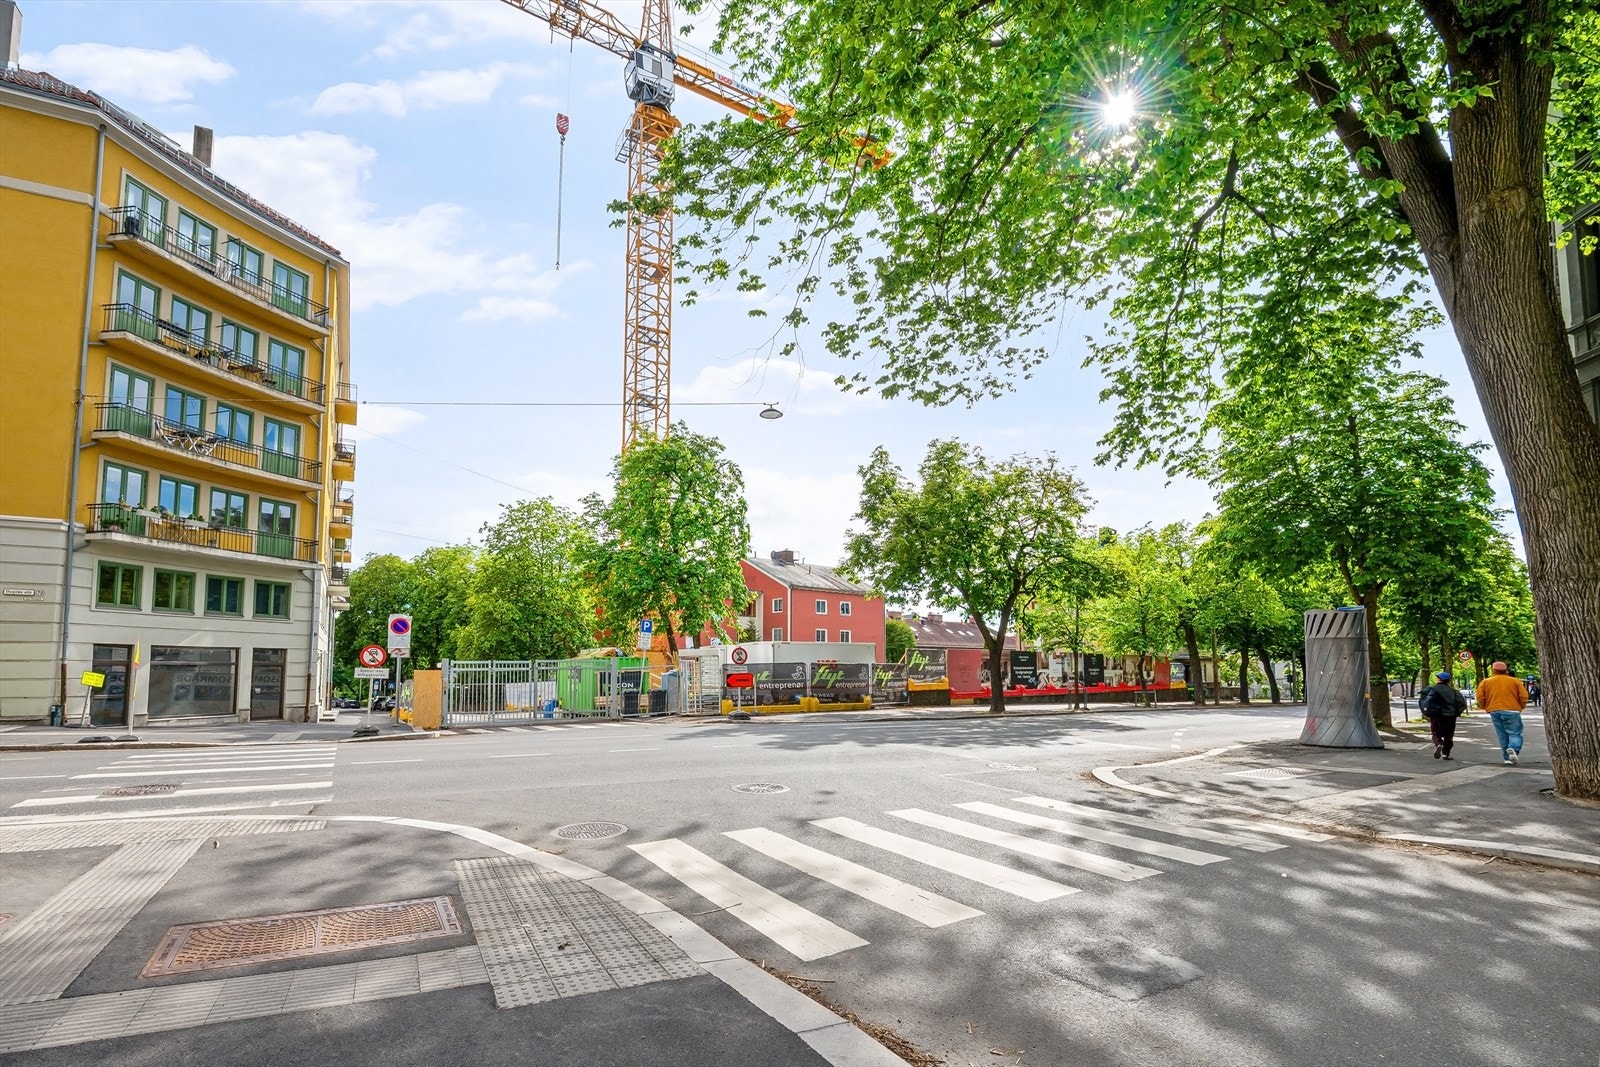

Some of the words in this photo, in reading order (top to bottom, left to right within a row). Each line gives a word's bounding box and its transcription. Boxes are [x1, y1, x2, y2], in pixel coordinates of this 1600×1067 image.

[644, 621, 651, 631] P
[909, 650, 930, 671] flyt
[811, 665, 845, 689] flyt
[759, 682, 804, 690] entreprenør
